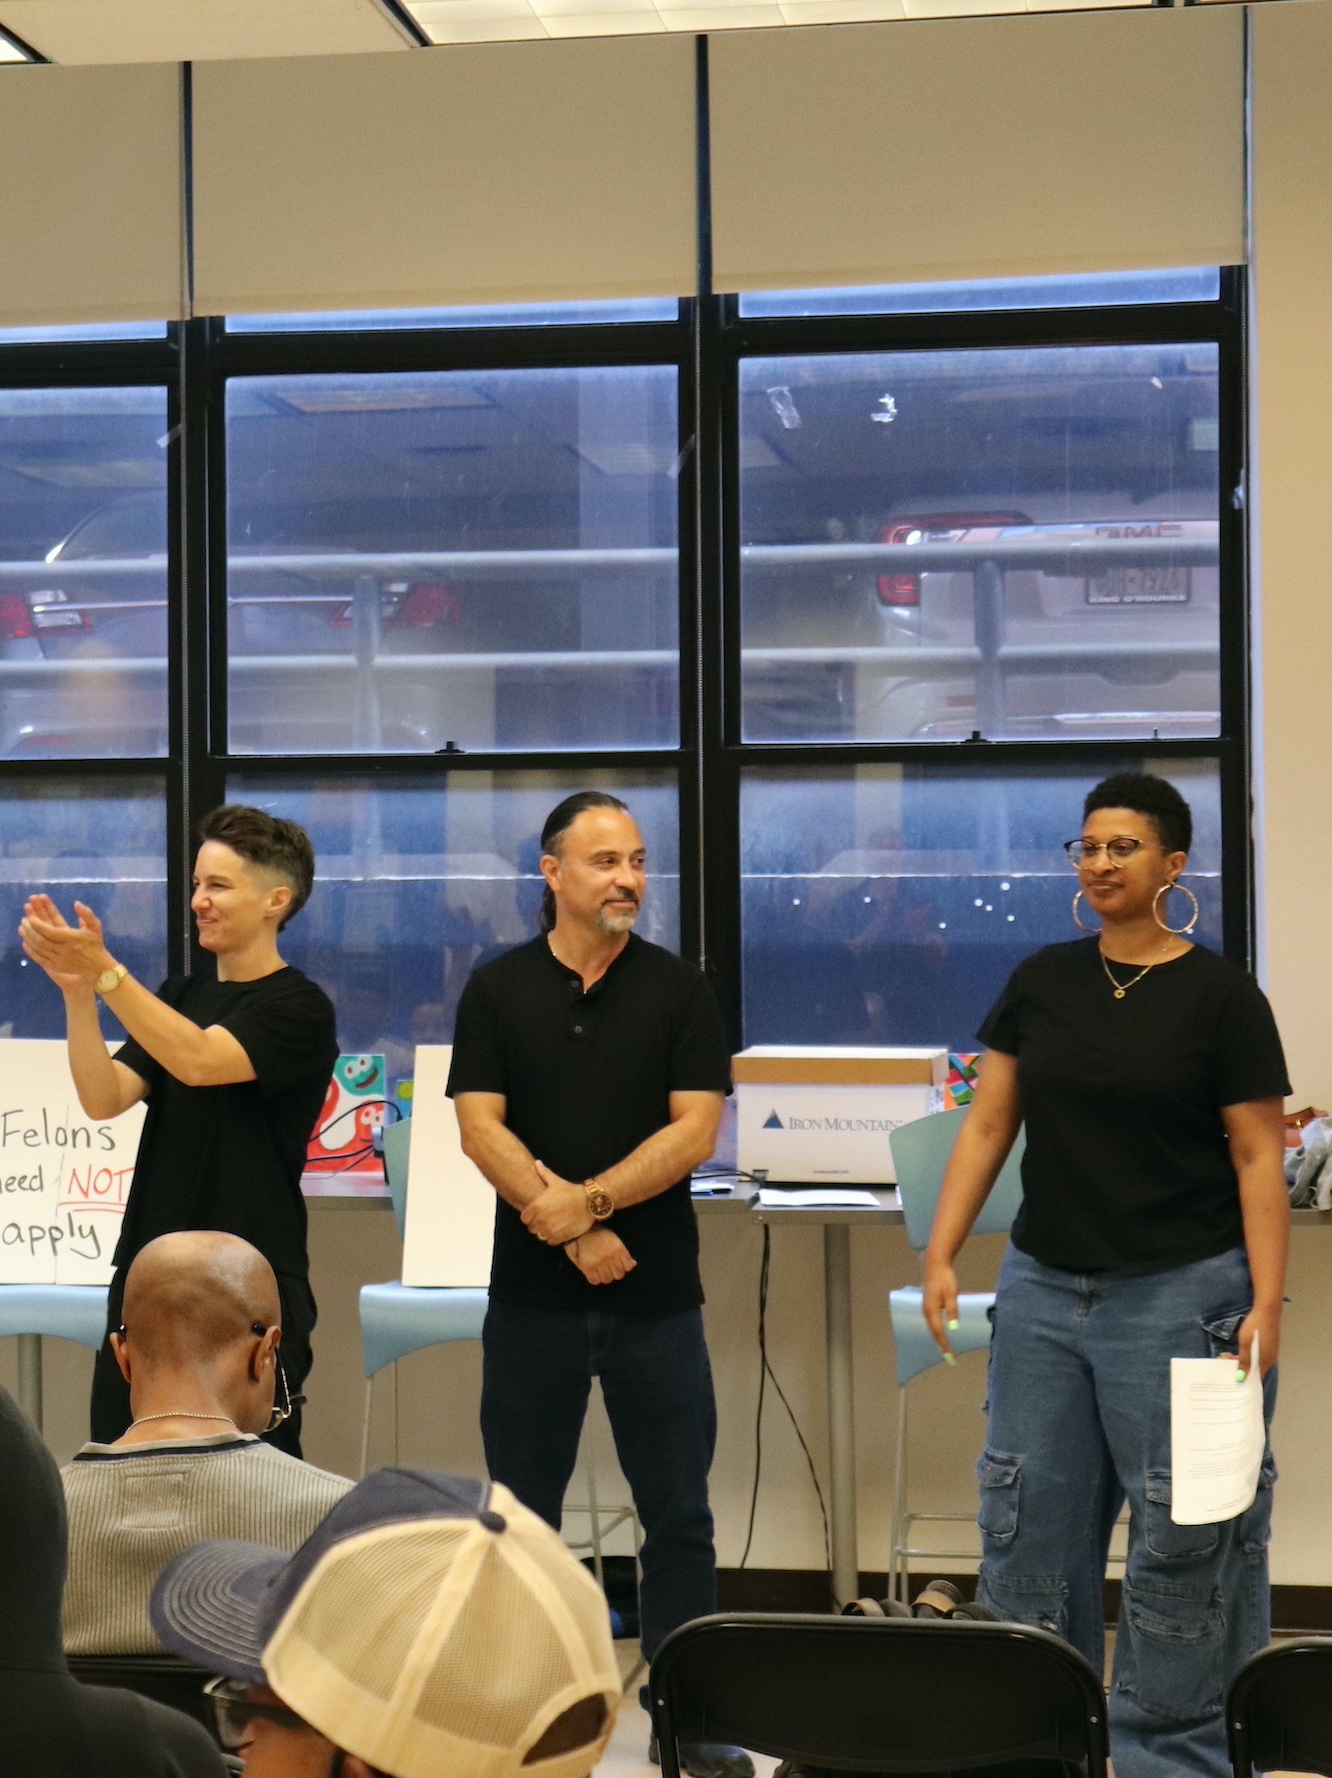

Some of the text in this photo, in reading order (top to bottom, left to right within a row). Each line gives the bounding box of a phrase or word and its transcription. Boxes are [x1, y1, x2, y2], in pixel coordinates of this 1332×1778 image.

[1095, 525, 1182, 539] GMC
[1, 1107, 116, 1151] Felons
[789, 1117, 822, 1130] IRON
[68, 1163, 136, 1203] NOT
[2, 1212, 101, 1260] apply
